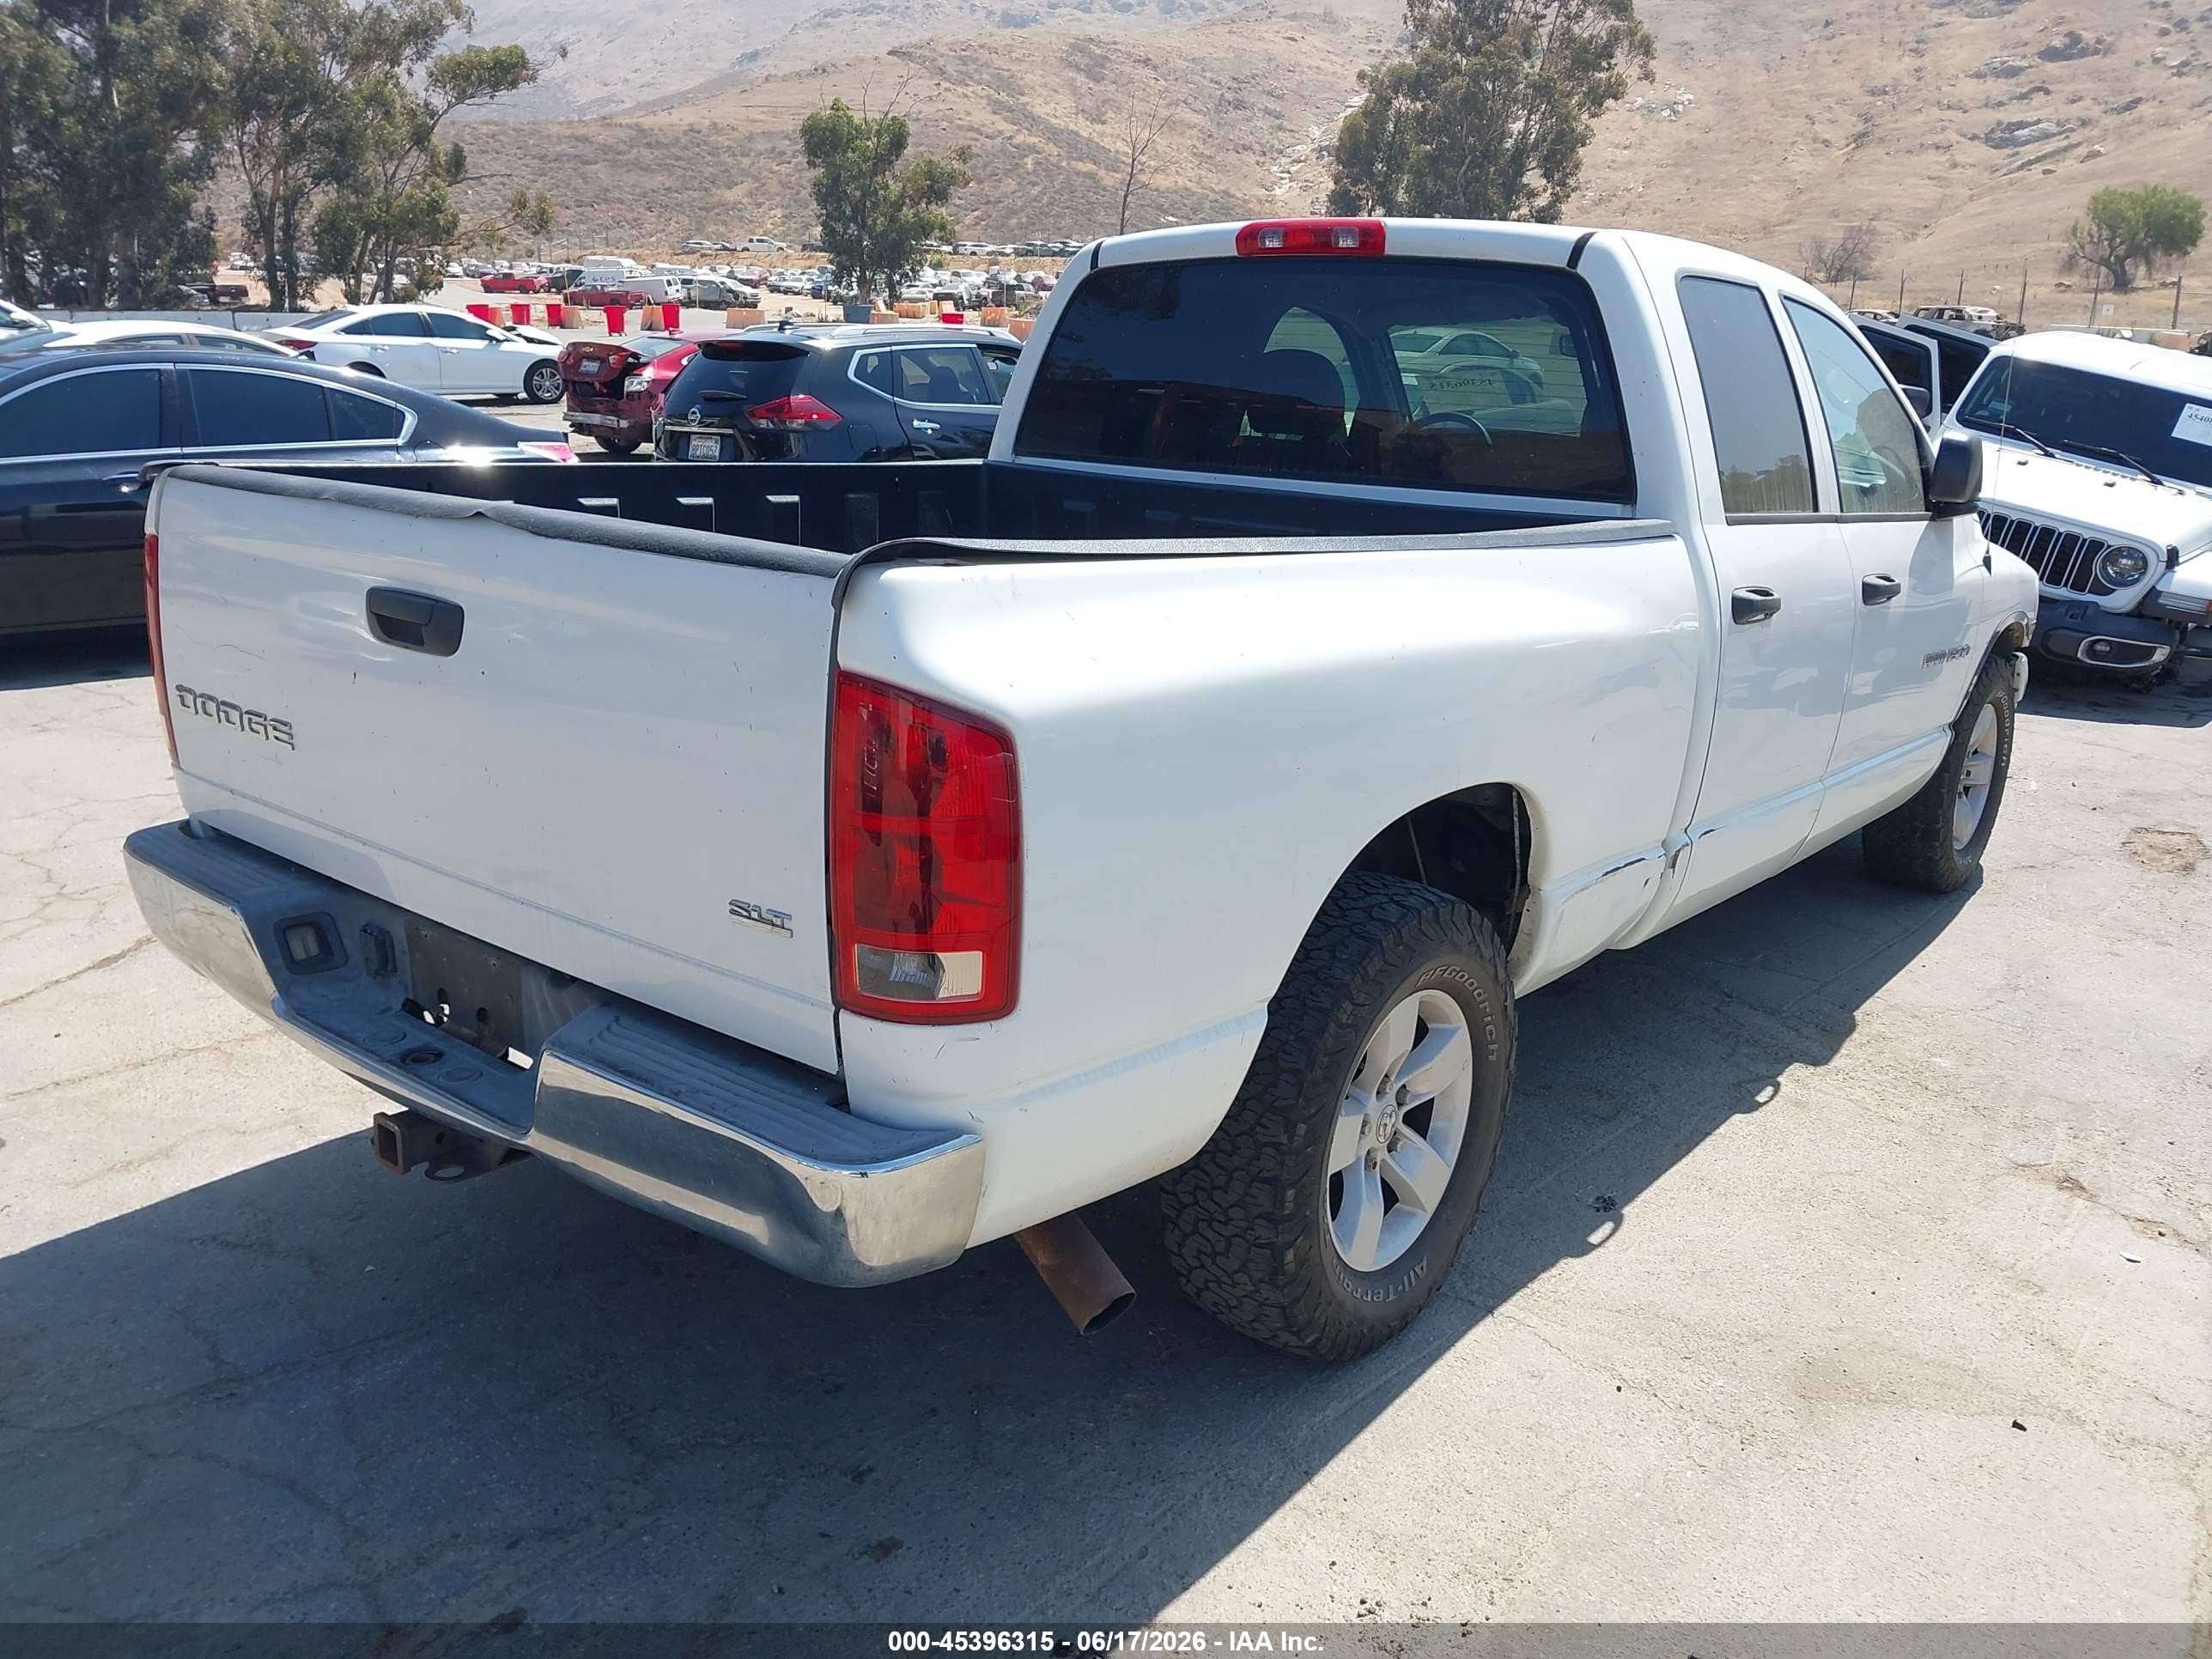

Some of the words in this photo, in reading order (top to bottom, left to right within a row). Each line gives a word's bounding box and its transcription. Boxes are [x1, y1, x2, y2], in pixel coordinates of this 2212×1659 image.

[2186, 412, 2212, 424] 4540
[175, 684, 295, 751] DODGE
[727, 898, 793, 934] SLT
[1414, 964, 1499, 1061] BFGoodrich
